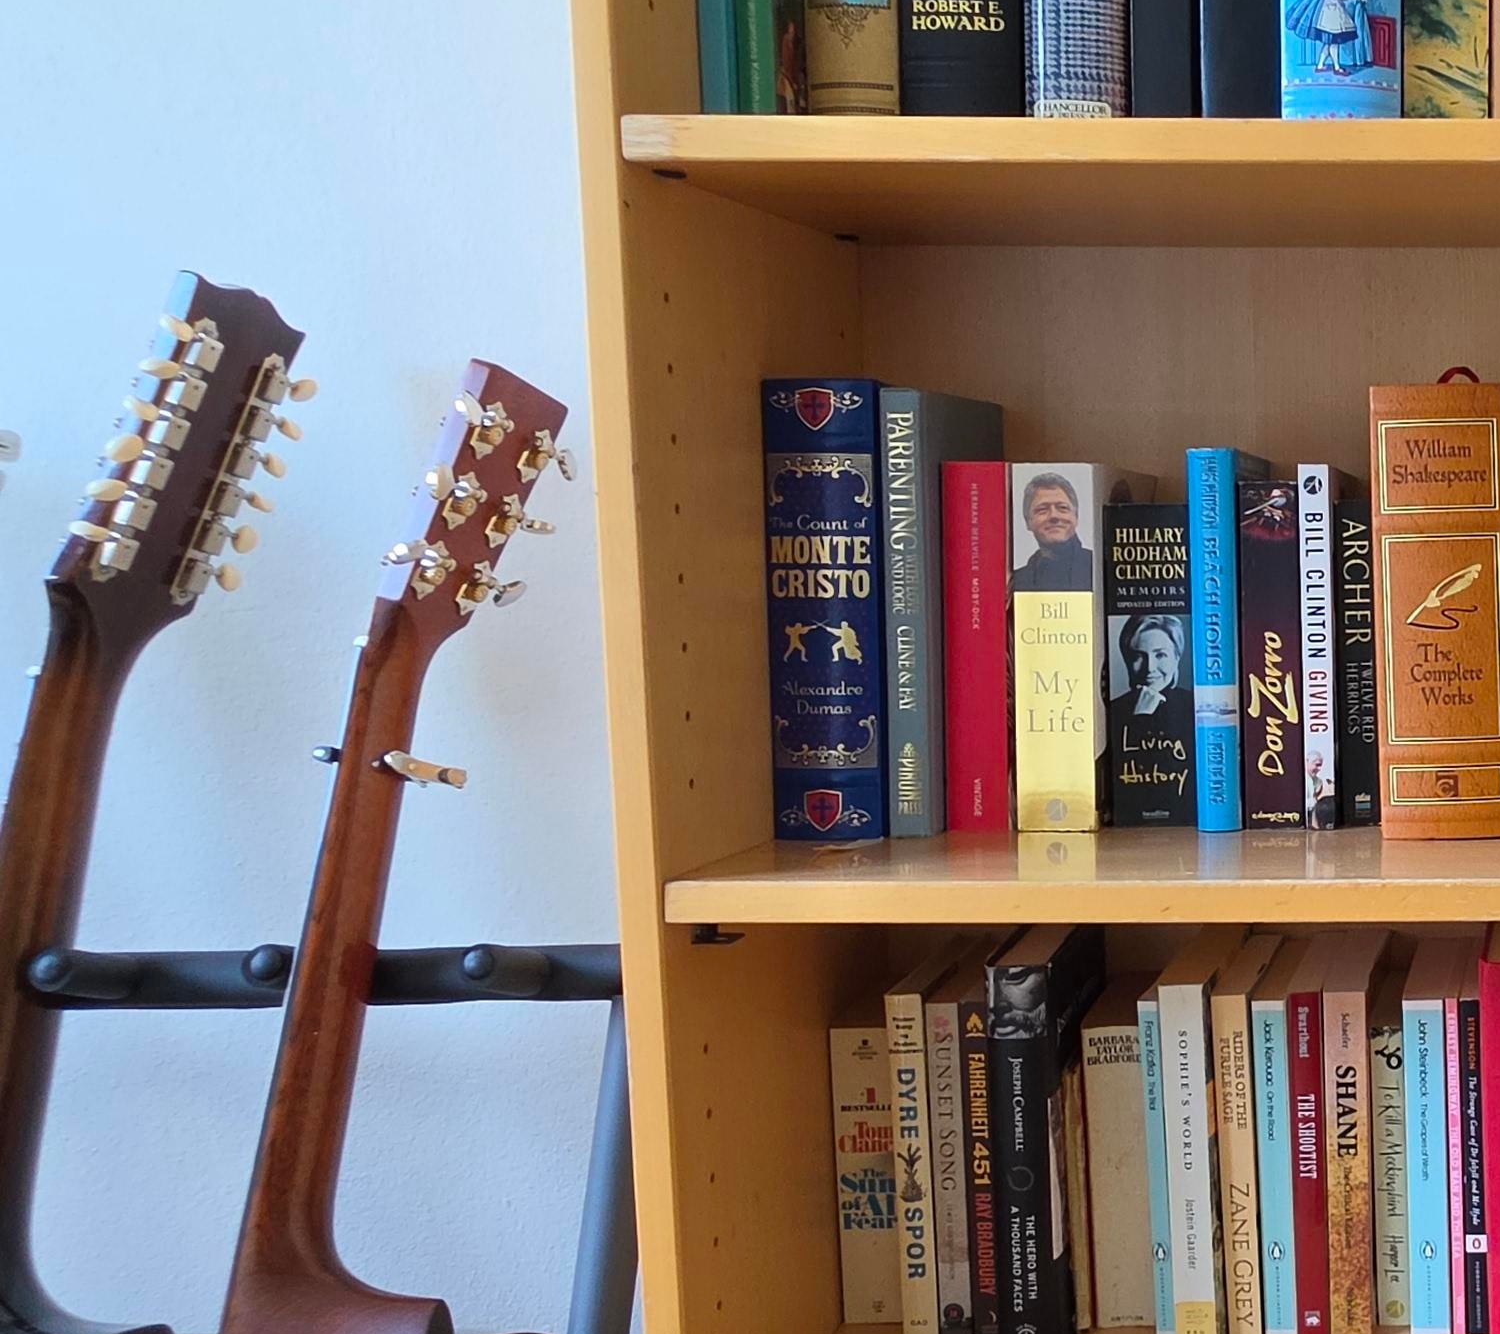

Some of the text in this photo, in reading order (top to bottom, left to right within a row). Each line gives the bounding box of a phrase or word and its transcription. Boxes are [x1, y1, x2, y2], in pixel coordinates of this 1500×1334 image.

[912, 0, 1003, 14] ROBERT E.
[912, 15, 1005, 32] HOWARD
[1405, 439, 1472, 460] William
[885, 411, 917, 551] PARENTING
[1392, 464, 1487, 488] Shakespeare
[797, 515, 867, 532] Count of
[1114, 527, 1185, 545] HILLARY
[770, 535, 872, 565] MONTE
[1113, 546, 1188, 563] RODHAM
[772, 569, 870, 599] CRISTO
[1114, 563, 1186, 580] CLINTON
[1341, 518, 1372, 646] ARCHER
[1116, 586, 1186, 597] MEMOIRS
[1040, 602, 1069, 620] Bill
[1304, 512, 1329, 733] BILL CLINTON GIVING
[1020, 627, 1088, 646] Clinton
[1417, 642, 1454, 663] The
[783, 681, 864, 696] Alexandre
[1034, 670, 1080, 702] My
[1410, 663, 1484, 687] Complete
[797, 700, 852, 716] Dumas
[1346, 662, 1360, 735] HERRINGS
[1360, 662, 1375, 744] TWELVE RED
[1420, 686, 1474, 707] Works
[1026, 709, 1085, 734] Life
[1123, 726, 1187, 760] Living
[1119, 765, 1189, 796] History
[897, 1068, 919, 1139] DYRE
[1008, 1057, 1025, 1153] JOSEPH CAMPBELL
[1178, 1030, 1193, 1172] SOPHIE'S WORLD
[1335, 1065, 1358, 1158] SHANE
[968, 1053, 991, 1186] FAHRENHEIT 451
[1297, 1093, 1317, 1179] THE SHOOTIST
[904, 1208, 926, 1280] SPOR
[1025, 1215, 1038, 1300] THE HERO WITH
[1229, 1183, 1255, 1327] ZANE GREY
[1010, 1206, 1024, 1313] A THOUSAND FACES
